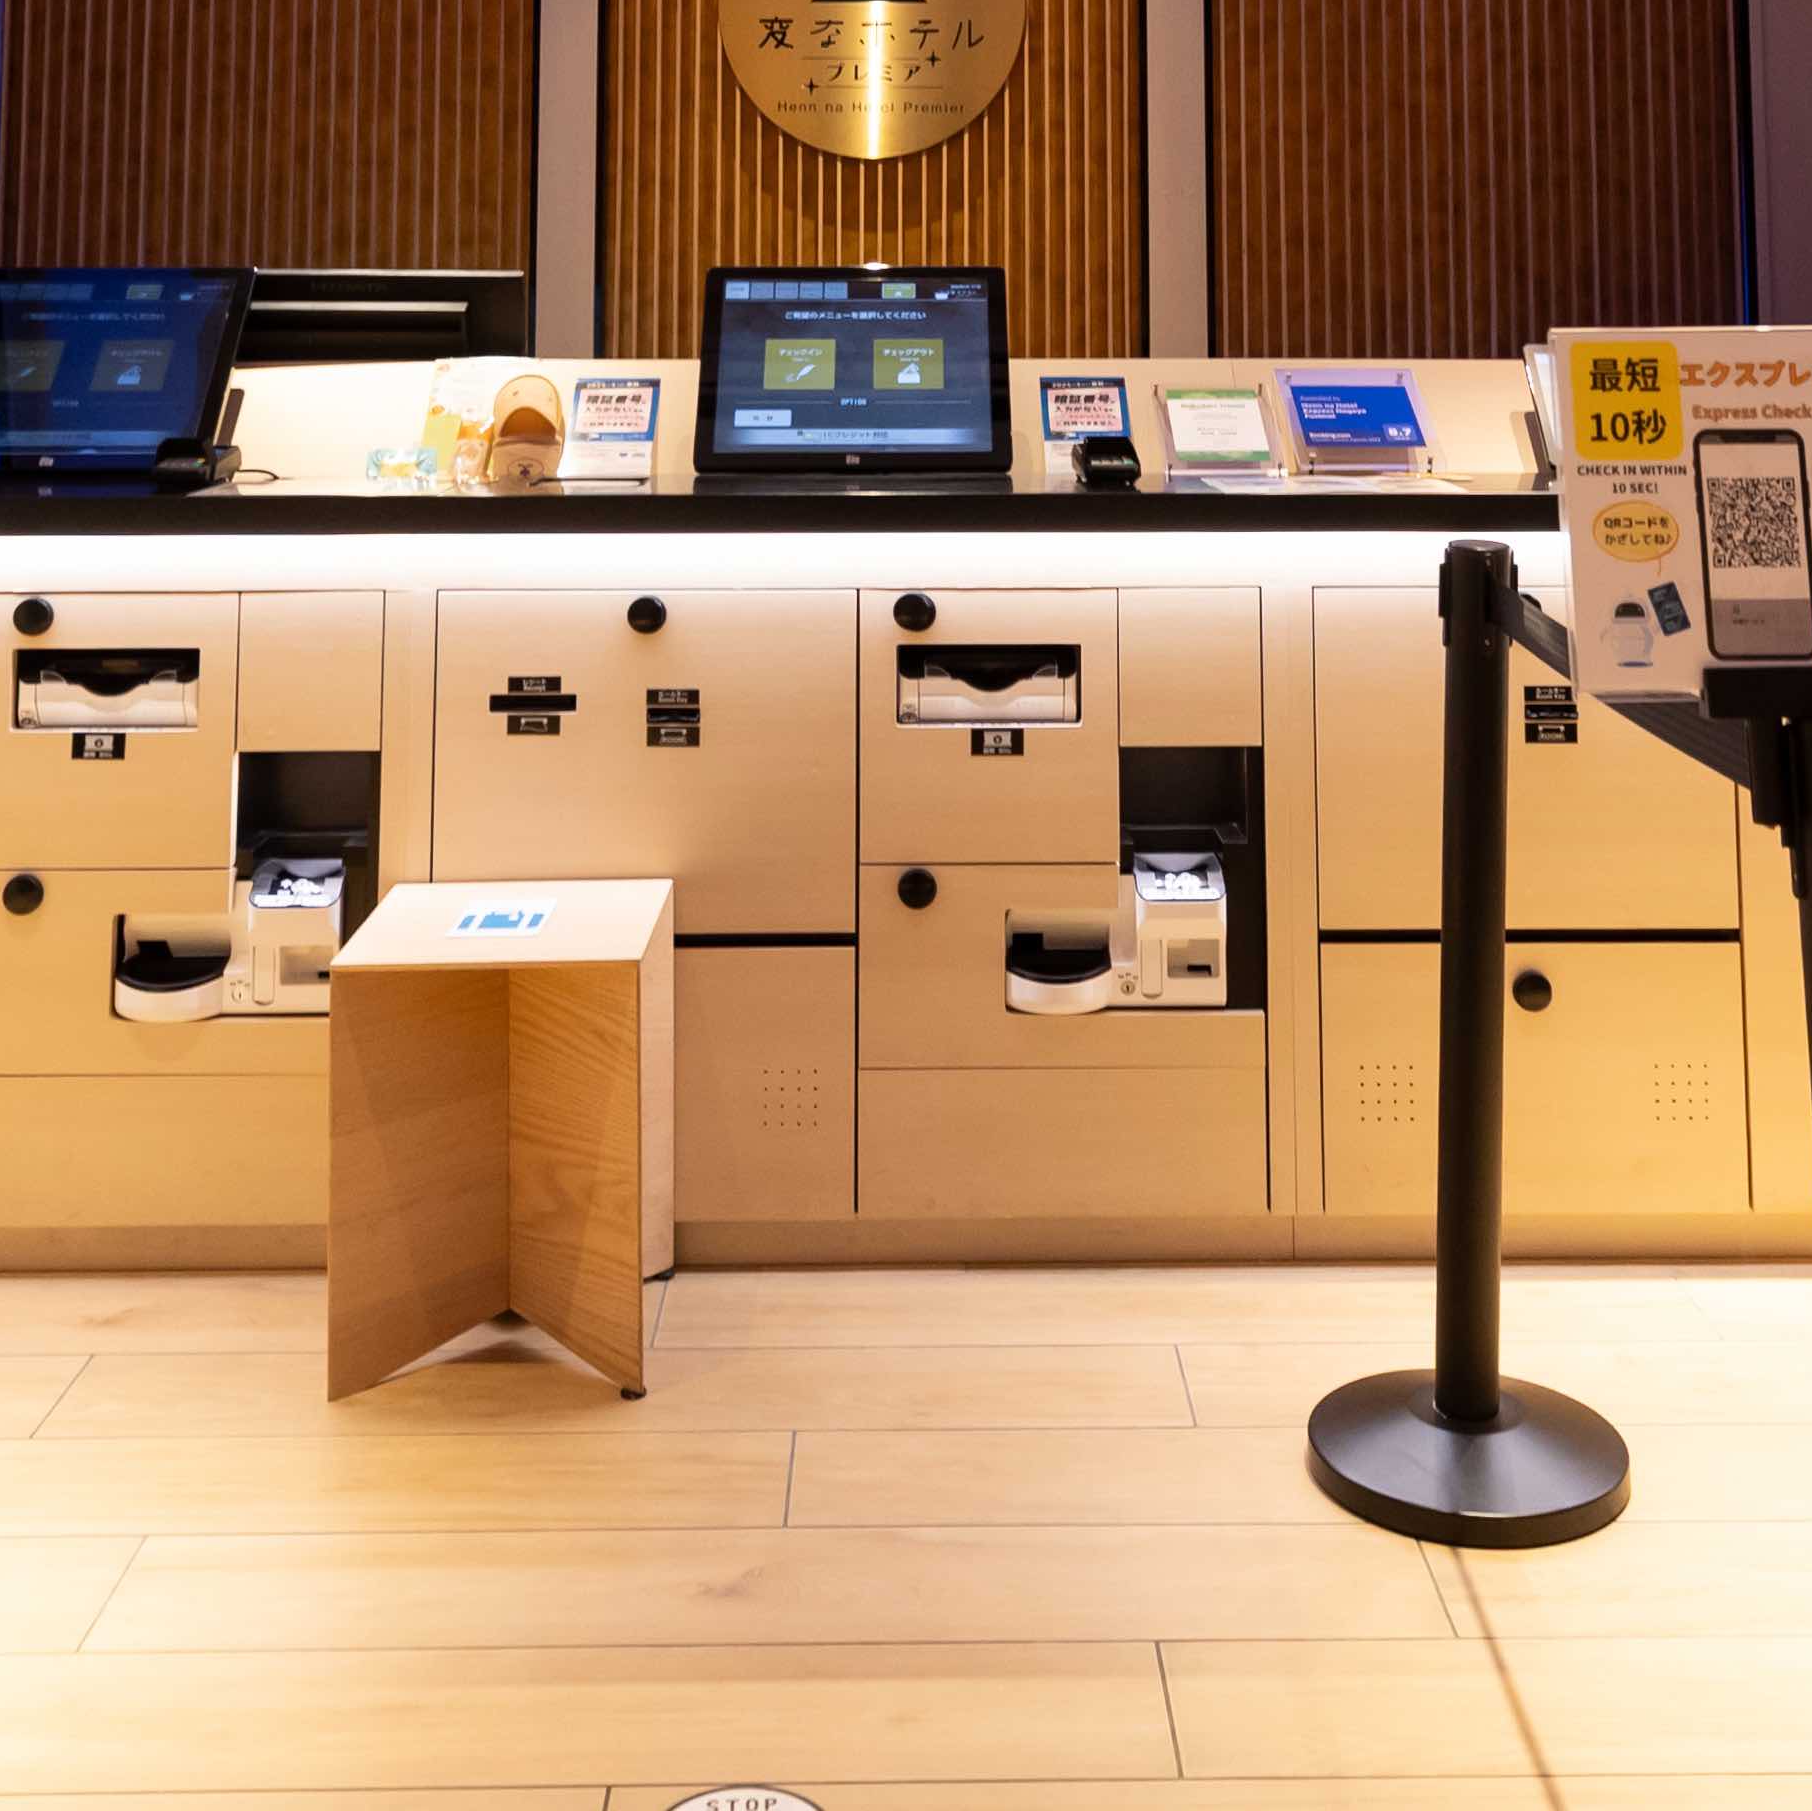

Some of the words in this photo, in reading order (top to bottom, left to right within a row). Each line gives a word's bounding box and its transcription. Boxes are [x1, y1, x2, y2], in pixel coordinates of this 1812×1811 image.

[758, 16, 985, 50] 変なホテル
[903, 101, 965, 114] Premier
[1589, 357, 1662, 393] 最短
[1691, 403, 1758, 422] Express
[1589, 407, 1667, 445] 10秒
[1576, 464, 1621, 476] CHECK
[1623, 465, 1638, 476] IN
[1639, 465, 1688, 476] WITHIN
[1612, 482, 1627, 494] 10
[1603, 517, 1669, 529] QRコードを
[706, 1797, 778, 1811] STOP
